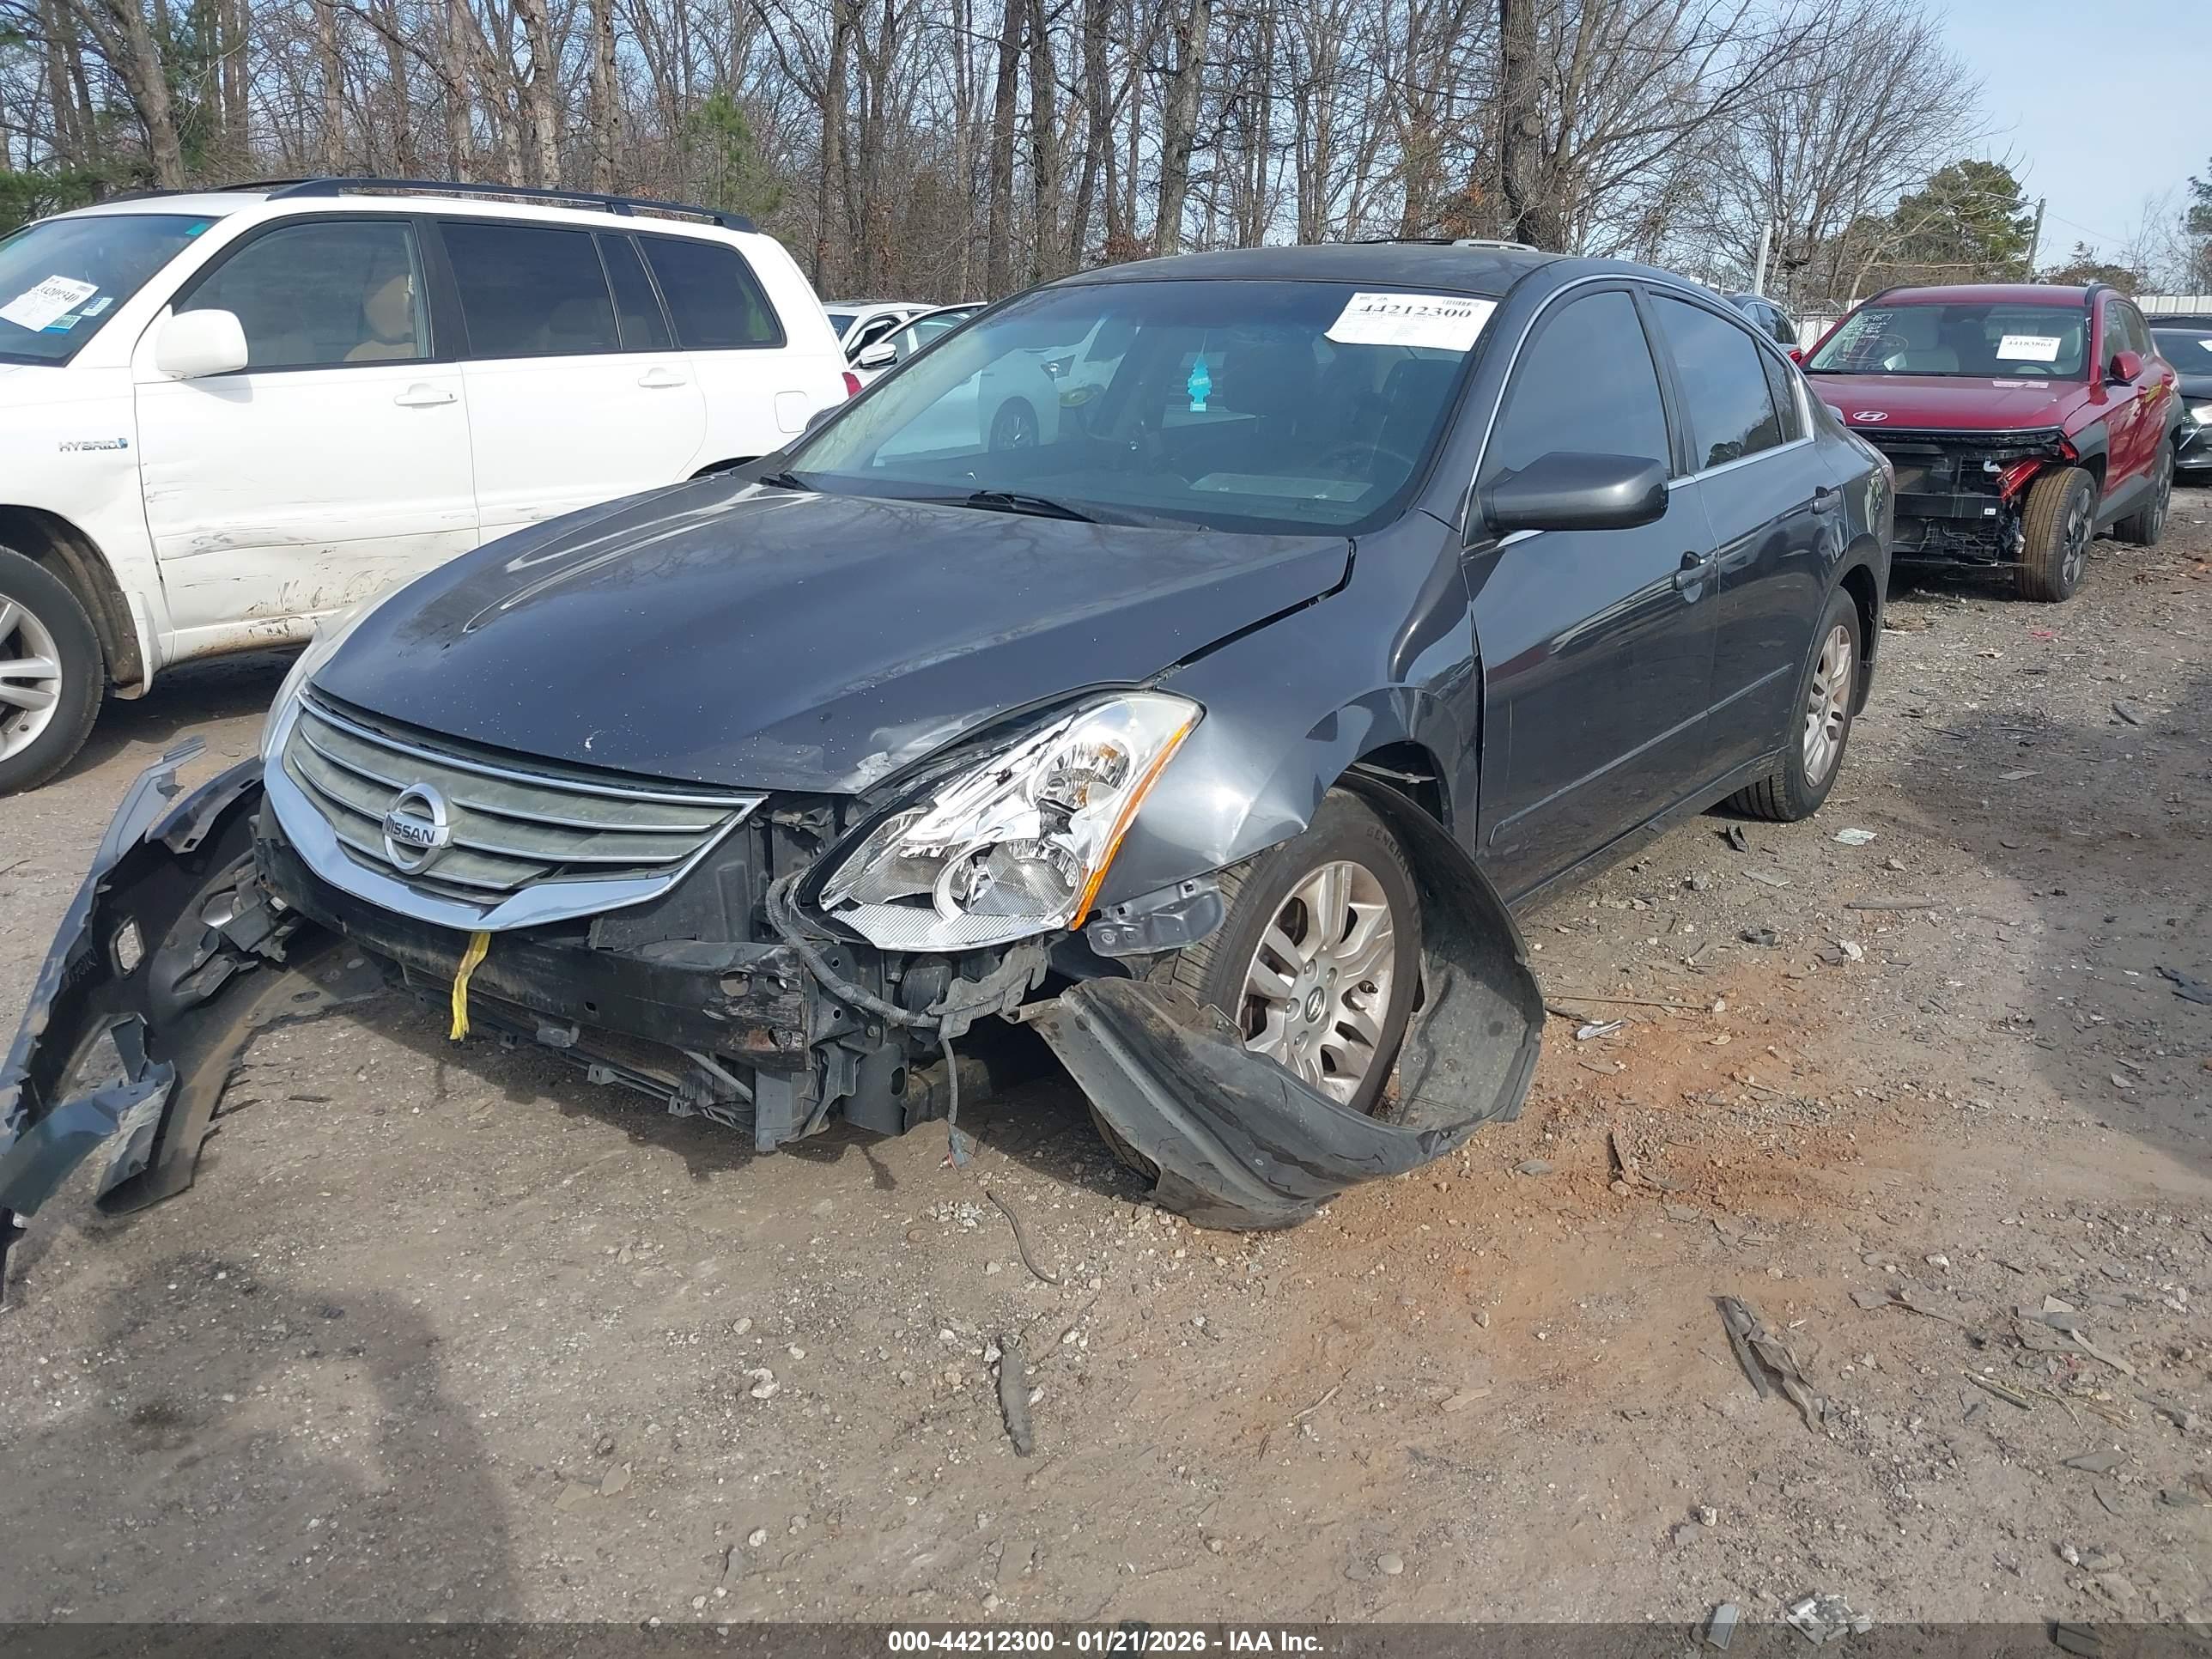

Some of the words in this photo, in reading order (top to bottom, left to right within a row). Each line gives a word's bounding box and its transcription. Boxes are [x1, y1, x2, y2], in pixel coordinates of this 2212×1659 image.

[1359, 304, 1473, 319] 44212300
[58, 441, 118, 452] HYBRID
[384, 816, 435, 844] NISSAN
